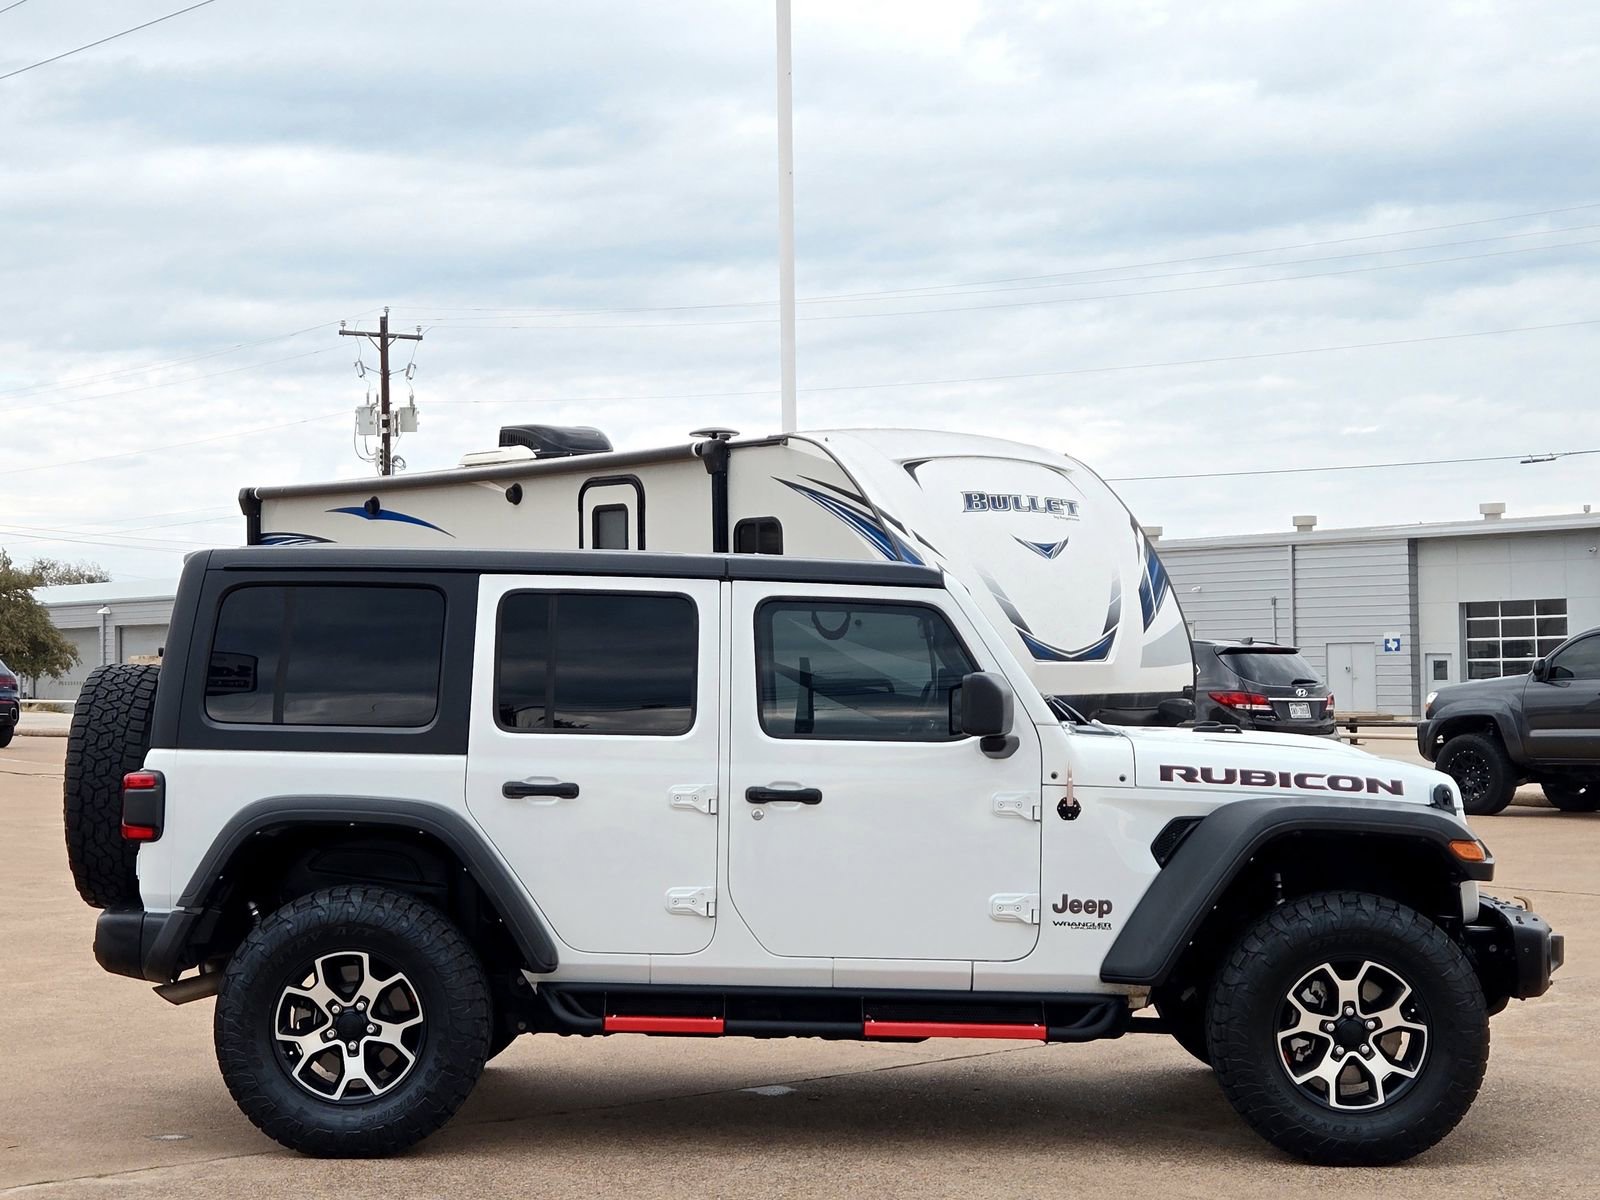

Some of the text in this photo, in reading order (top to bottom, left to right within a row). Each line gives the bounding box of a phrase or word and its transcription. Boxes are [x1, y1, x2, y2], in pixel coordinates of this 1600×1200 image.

[960, 491, 1079, 517] BULLET
[1159, 764, 1404, 796] RUBICON
[1052, 893, 1113, 919] Jeep
[1052, 920, 1112, 928] WRANGLER
